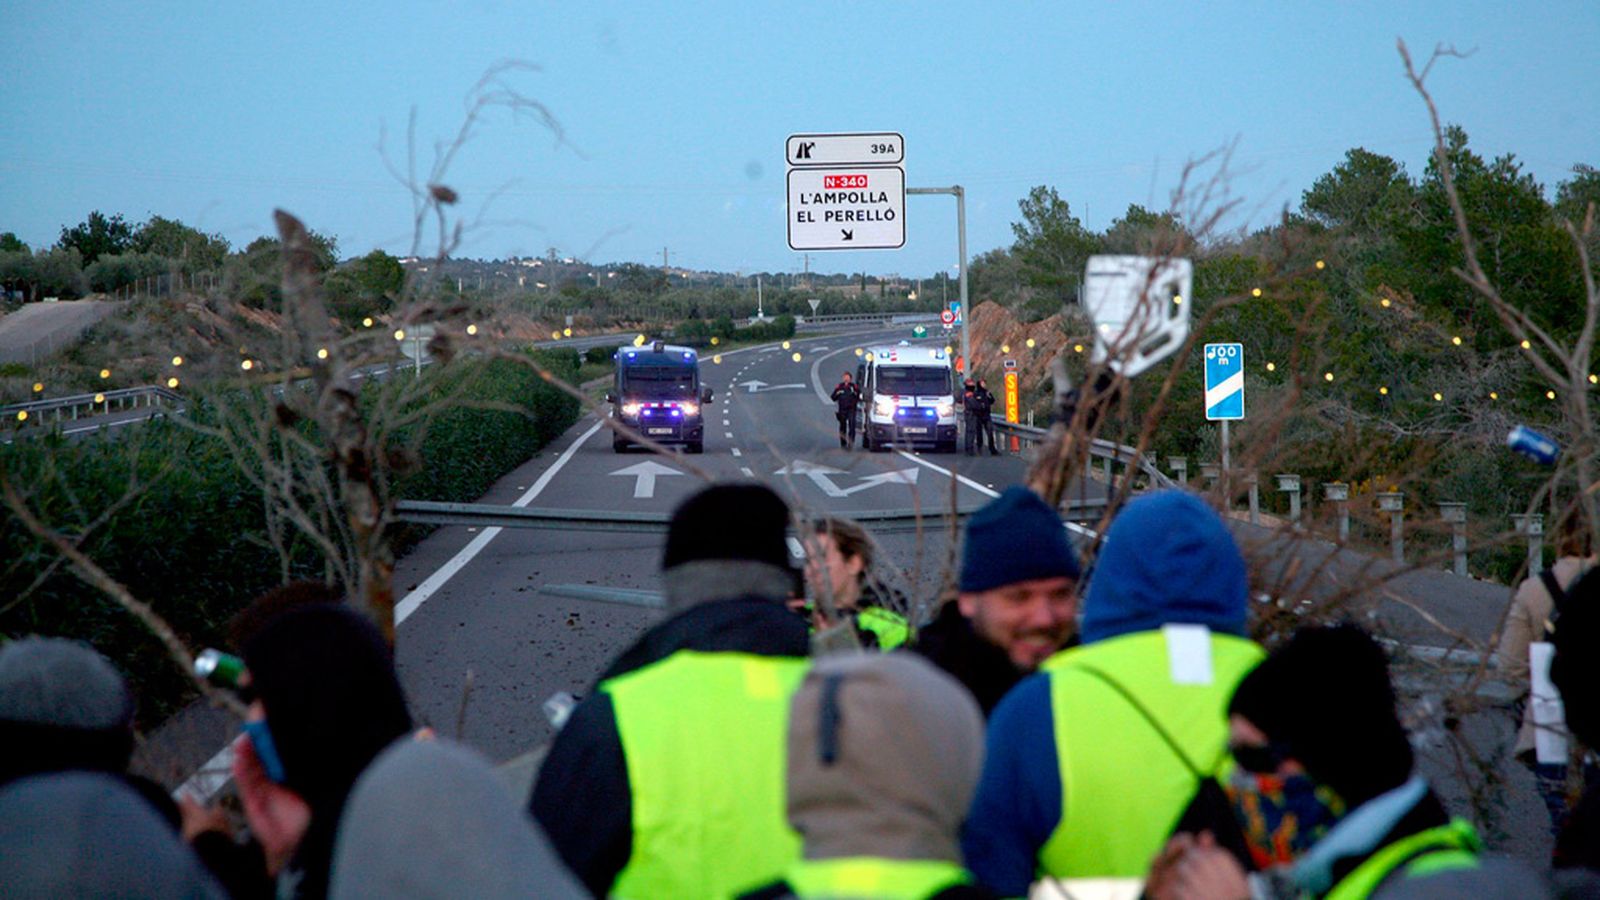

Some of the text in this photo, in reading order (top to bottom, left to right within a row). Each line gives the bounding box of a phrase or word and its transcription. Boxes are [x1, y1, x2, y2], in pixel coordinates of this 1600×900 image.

[871, 144, 895, 154] 39A
[825, 175, 866, 187] N-340
[800, 191, 888, 205] L'AMPOLLA
[797, 208, 896, 223] EL PERELLÓ
[1218, 357, 1229, 366] m
[1007, 374, 1017, 422] SOS
